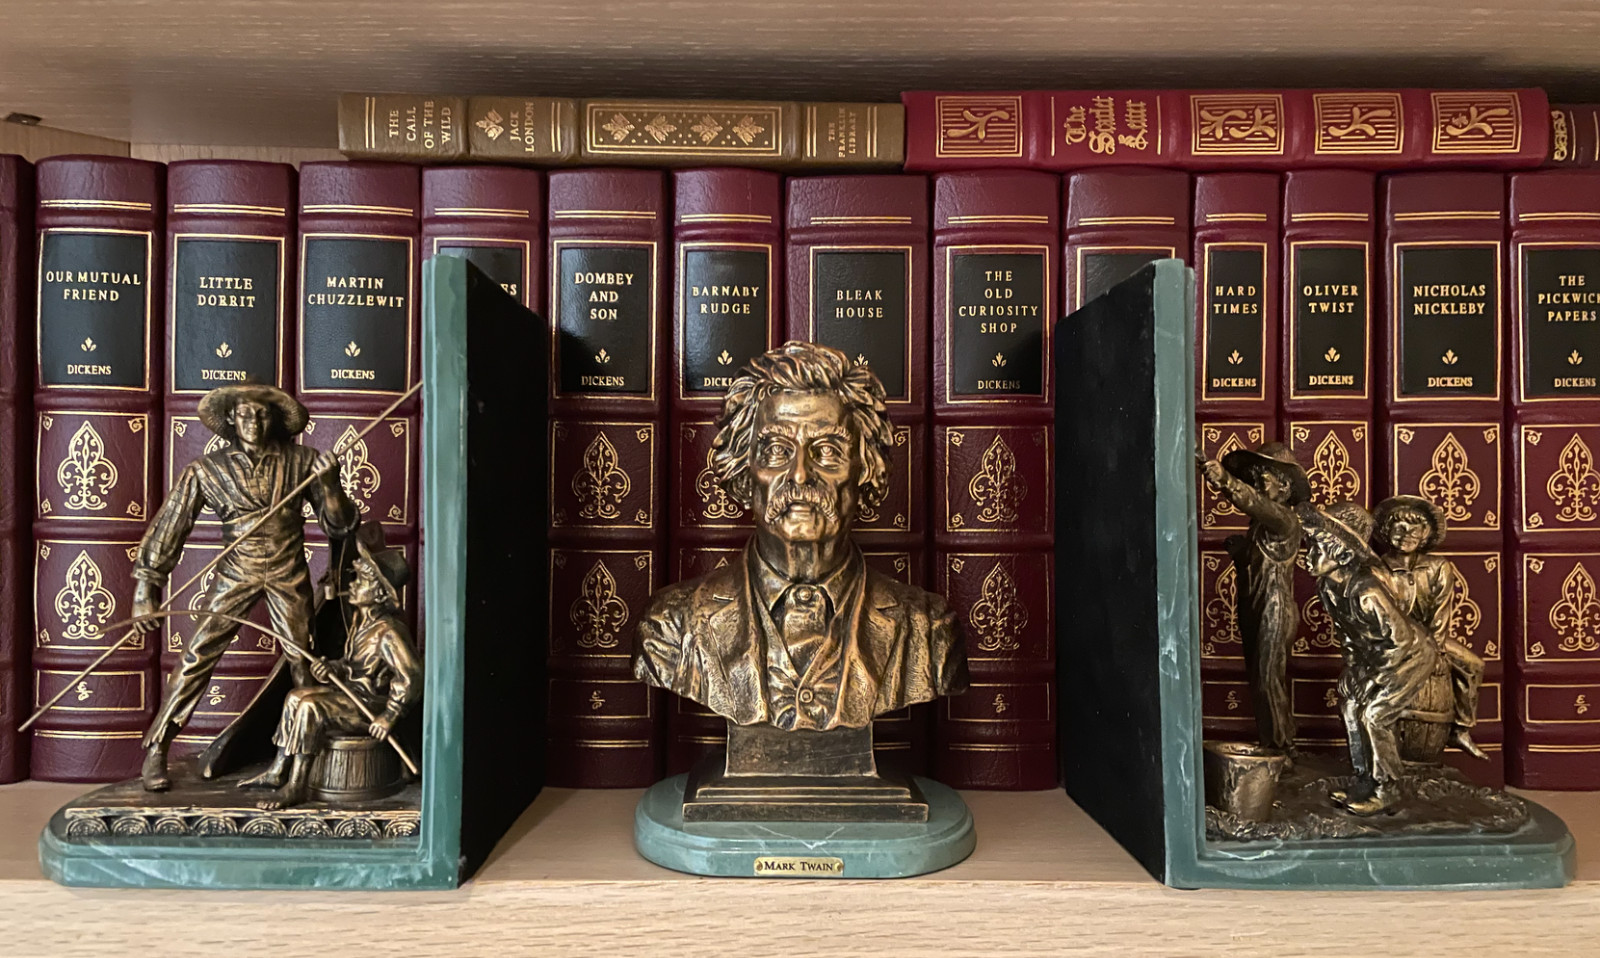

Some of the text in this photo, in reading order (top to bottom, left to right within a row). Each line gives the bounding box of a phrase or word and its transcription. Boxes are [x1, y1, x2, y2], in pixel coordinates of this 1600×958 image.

[389, 110, 399, 137] THE
[407, 107, 416, 141] CALL
[424, 101, 434, 148] OF THE
[440, 107, 451, 145] WILD
[510, 112, 521, 141] JACK
[525, 102, 534, 152] LONDON
[1064, 106, 1086, 145] The
[1089, 96, 1116, 154] Scarlet
[1118, 99, 1148, 150] Letter
[46, 271, 140, 285] OUR MUTUAL
[575, 272, 634, 286] DOMBEY
[985, 271, 1012, 281] THE
[1559, 276, 1585, 286] THE
[200, 277, 252, 289] LITTLE
[327, 277, 383, 289] MARTIN
[64, 289, 119, 301] FRIEND
[691, 285, 759, 298] BARNABY
[837, 290, 882, 301] BLEAK
[985, 289, 1012, 298] OLD
[1216, 286, 1255, 296] HARD
[1304, 285, 1358, 296] OLIVER
[1414, 285, 1485, 297] NICHOLAS
[197, 294, 255, 307] DORRIT
[308, 292, 404, 307] CHUZZLEWIT
[589, 291, 618, 302] AND
[700, 303, 751, 315] RUDGE
[836, 308, 882, 318] HOUSE
[959, 306, 1037, 316] CURIOSITY
[1214, 304, 1257, 314] TIMES
[1309, 302, 1354, 313] TWIST
[1414, 303, 1485, 315] NICKLEBY
[590, 309, 617, 320] SON
[1548, 311, 1596, 321] PAPERS
[981, 323, 1016, 333] SHOP
[67, 365, 111, 374] DICKENS
[201, 369, 246, 380] DICKENS
[331, 369, 375, 379] DICKENS
[582, 376, 624, 386] DICKENS
[703, 377, 733, 387] DICKE
[977, 380, 1021, 390] DICKENS
[1213, 378, 1256, 387] DICKENS
[1309, 375, 1353, 385] DICKENS
[1428, 377, 1473, 387] DICKENS
[1555, 378, 1596, 387] DICKENS
